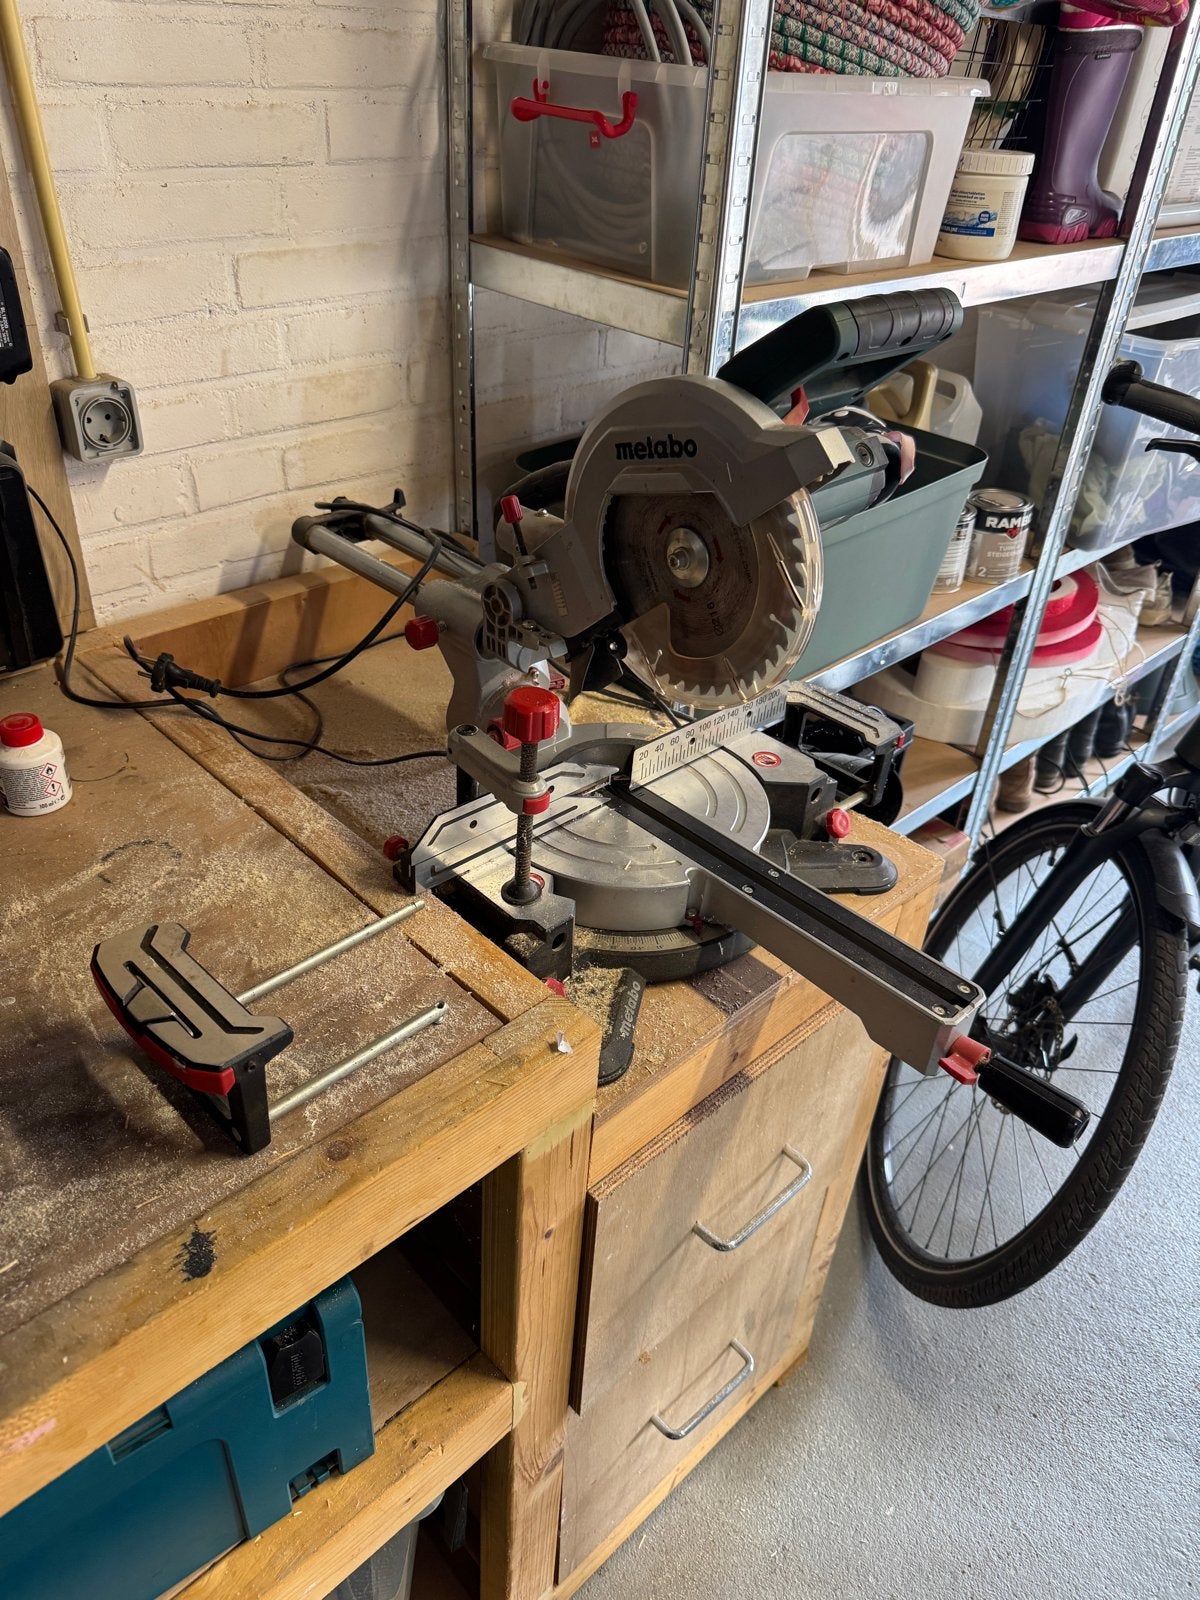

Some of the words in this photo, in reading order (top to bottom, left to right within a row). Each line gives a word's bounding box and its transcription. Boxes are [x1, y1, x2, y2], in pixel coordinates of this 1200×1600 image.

[615, 433, 698, 460] metabo
[985, 512, 1032, 528] RAMB
[977, 566, 987, 577] 2
[639, 750, 648, 761] 20
[654, 743, 664, 753] 40
[670, 736, 680, 746] 60
[685, 729, 695, 739] 80
[699, 720, 711, 733] 100
[713, 714, 726, 726] 120
[727, 708, 739, 720] 140
[742, 701, 753, 712] 160
[755, 695, 767, 706] 180
[768, 689, 780, 700] 200
[620, 980, 642, 1037] metabo
